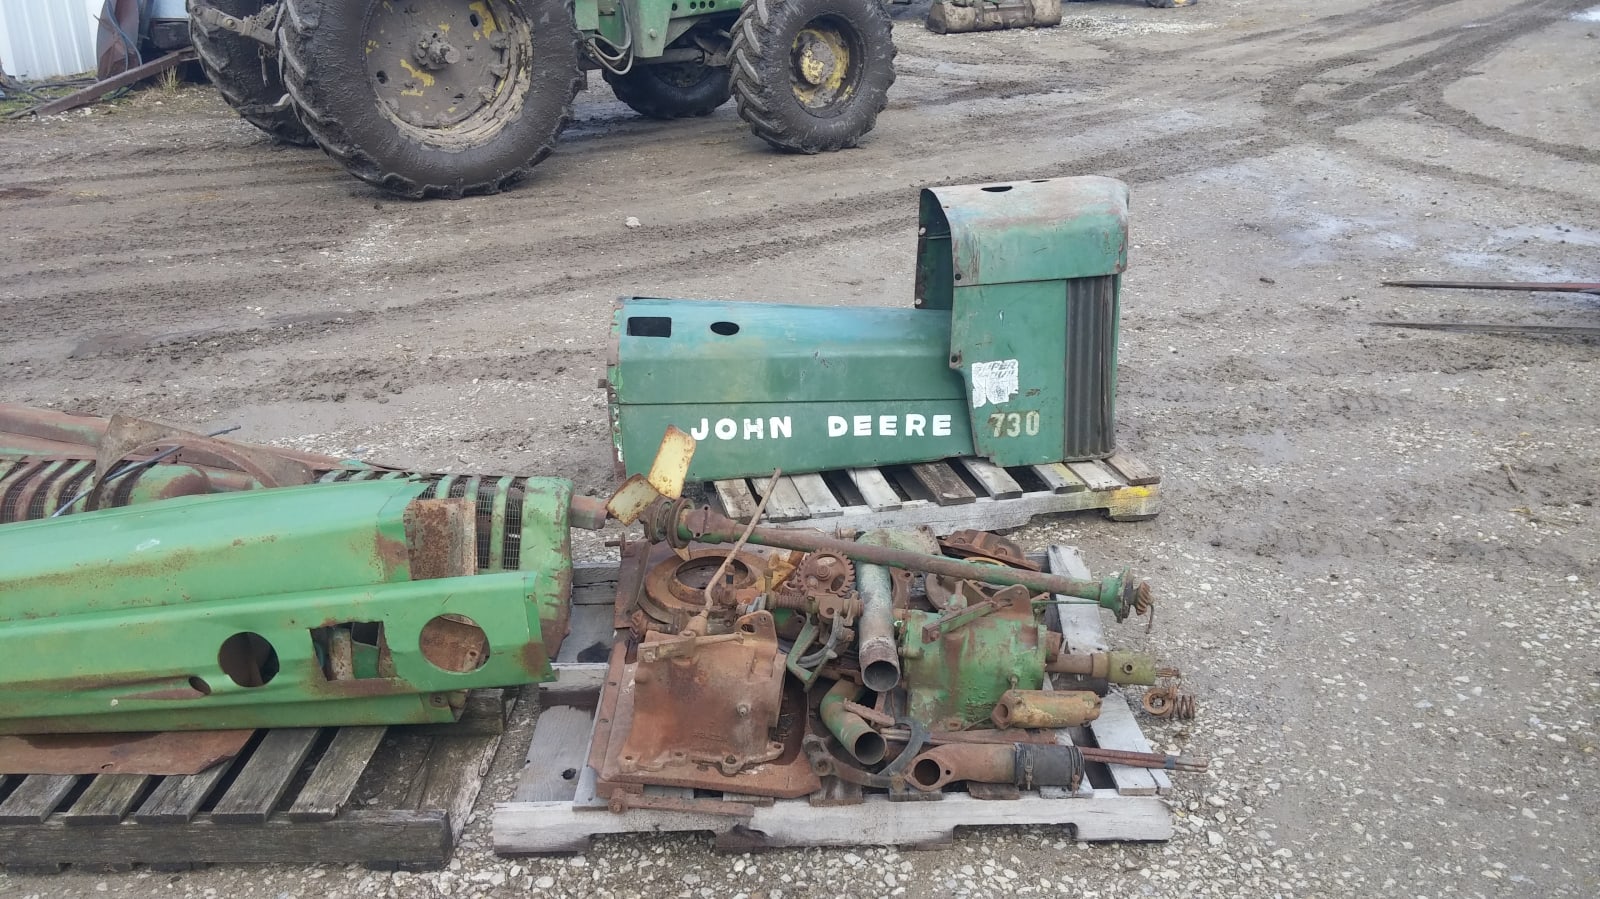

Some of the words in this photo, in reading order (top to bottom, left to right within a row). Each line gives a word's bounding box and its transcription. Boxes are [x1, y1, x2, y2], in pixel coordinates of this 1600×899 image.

[690, 415, 793, 440] JOHN
[827, 413, 952, 438] DEERE
[989, 411, 1040, 438] 730
